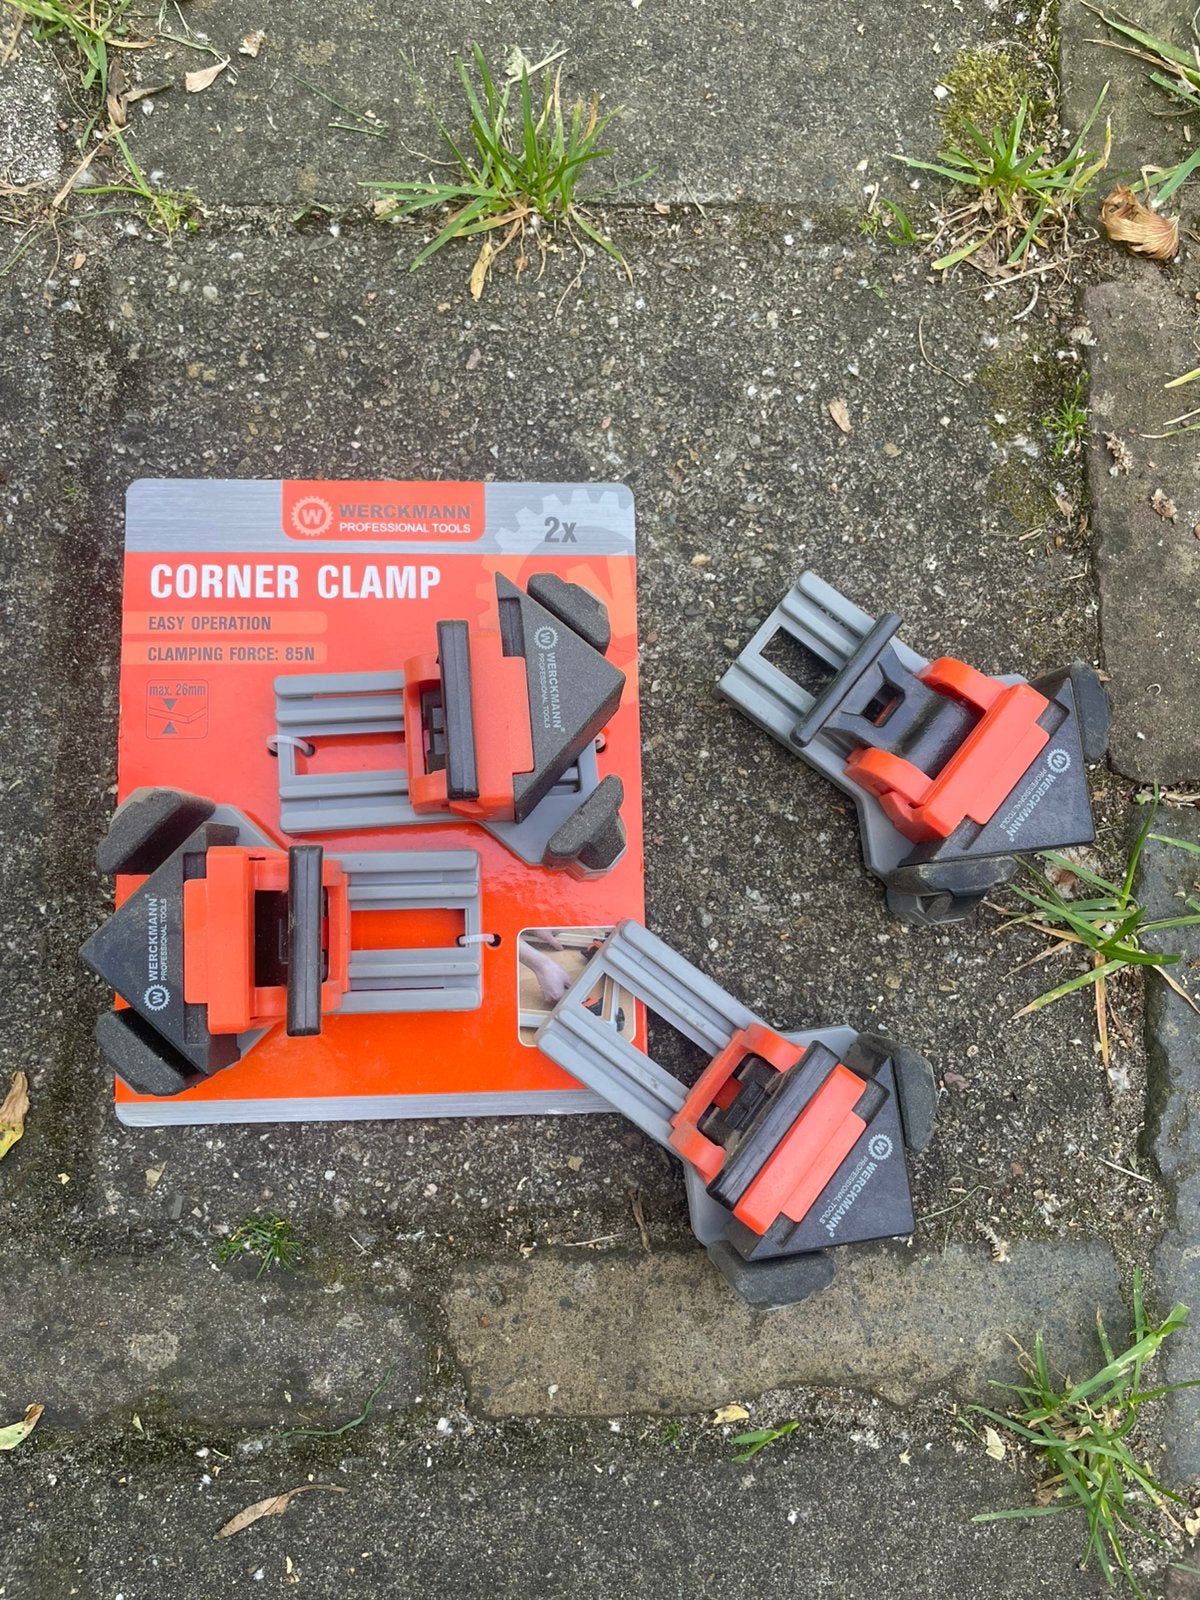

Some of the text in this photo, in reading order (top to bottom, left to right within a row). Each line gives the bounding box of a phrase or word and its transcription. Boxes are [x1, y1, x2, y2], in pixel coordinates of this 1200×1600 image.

[338, 504, 471, 519] WERCKMANN
[339, 522, 471, 534] PROFESSIONAL TOOLS
[544, 516, 577, 543] 2x
[150, 563, 441, 600] CORNER CLAMP
[149, 616, 271, 630] EASY OPERATION
[147, 647, 315, 661] CLAMPING FORCE: 85N
[149, 684, 206, 696] max. 26mm
[538, 653, 551, 728] PROFESSIONAL TOOLS
[547, 652, 561, 728] WERCKMANN
[999, 767, 1048, 829] PROFESSIONAL TOOLS
[1005, 773, 1057, 837] WERCKMANN
[148, 898, 158, 981] WERCKMANN
[819, 1155, 869, 1224] PROFESSIONAL TOOLS
[825, 1161, 878, 1232] WERCKMANN
